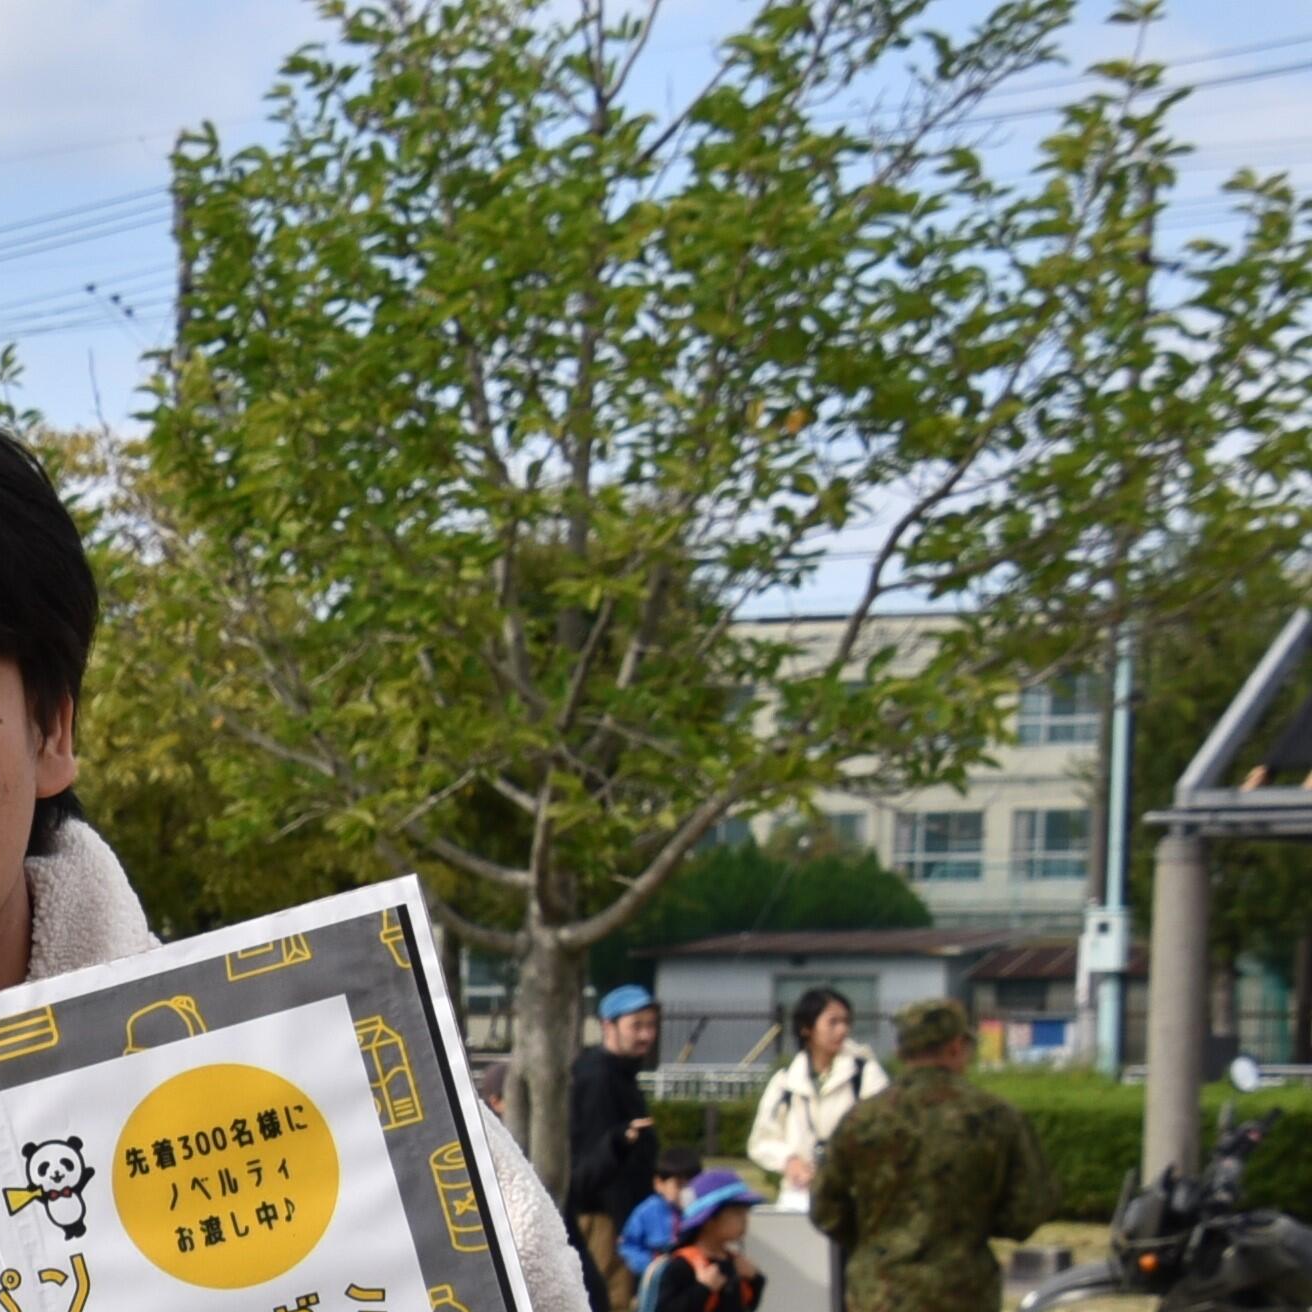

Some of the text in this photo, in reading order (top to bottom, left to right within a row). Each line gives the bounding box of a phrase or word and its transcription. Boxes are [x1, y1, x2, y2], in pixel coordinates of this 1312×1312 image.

[125, 1104, 308, 1178] 先着300名様に
[169, 1157, 290, 1211] ノベルティ
